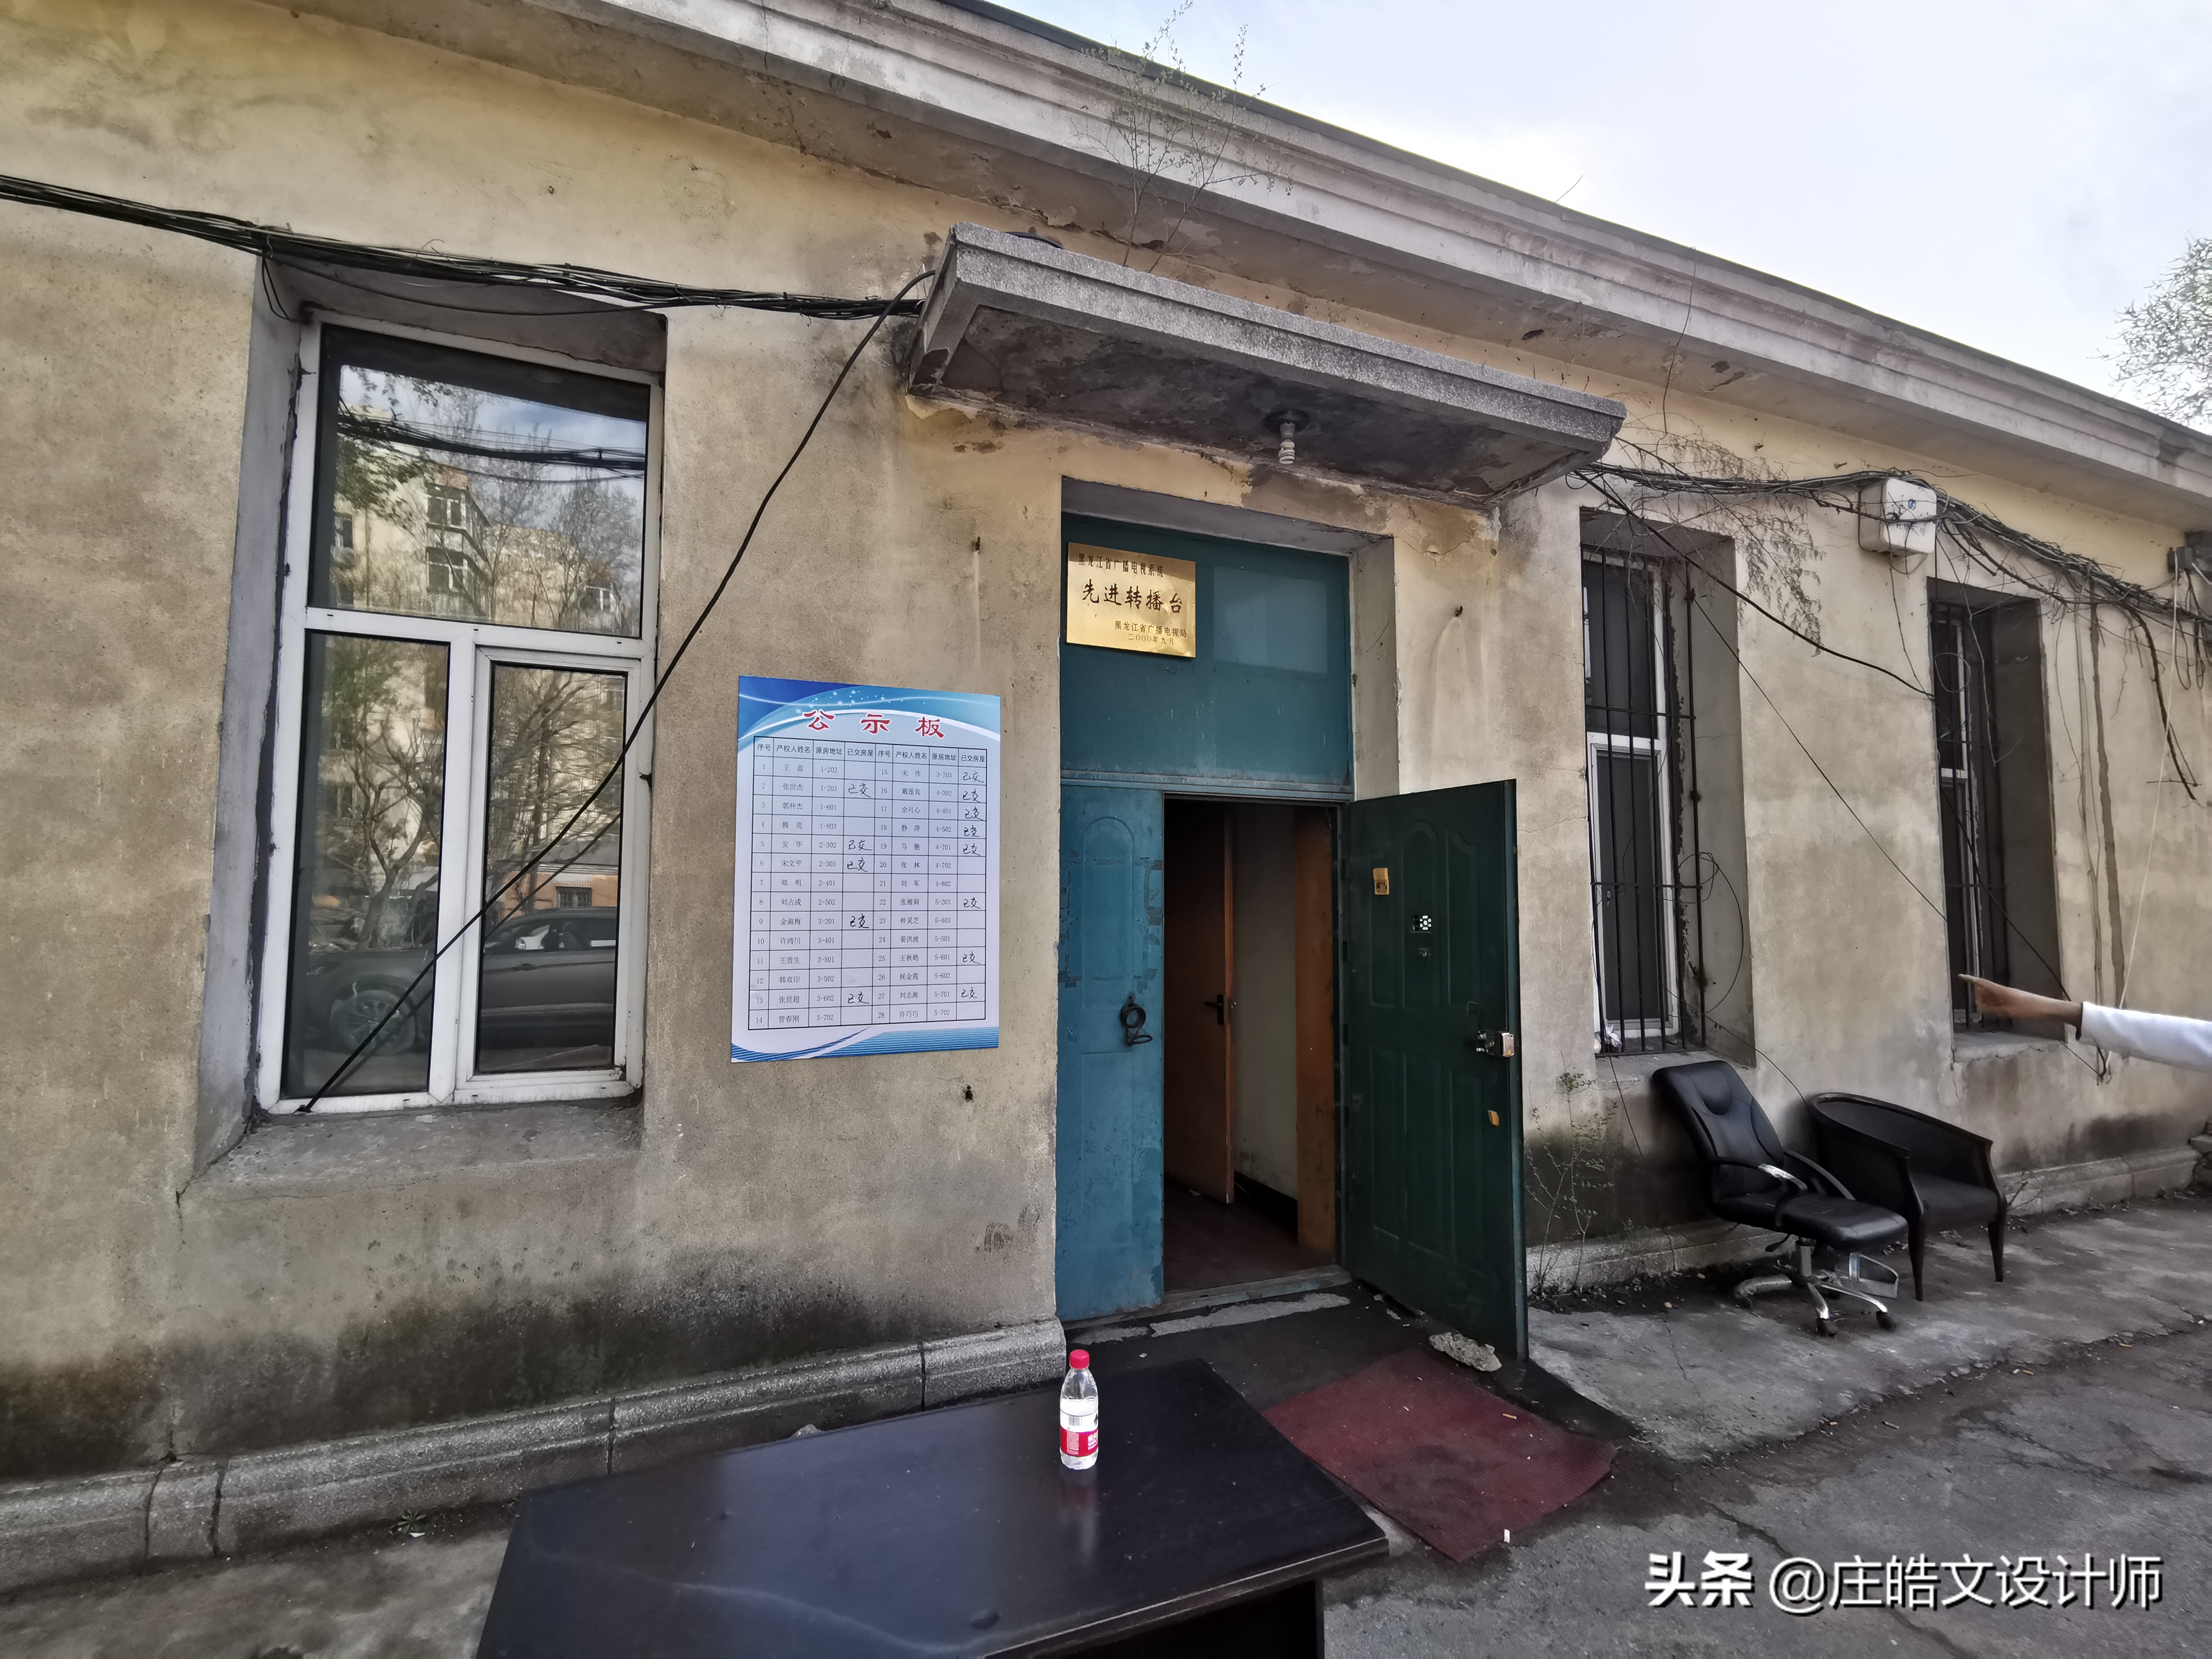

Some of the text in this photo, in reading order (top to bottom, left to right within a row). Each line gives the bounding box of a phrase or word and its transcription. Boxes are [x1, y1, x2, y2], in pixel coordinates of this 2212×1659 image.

[1078, 553, 1163, 578] 黑龙江省广播电视系统
[1082, 578, 1183, 613] 先进转播台
[1114, 620, 1187, 638] 黑龙江省广播电视局
[802, 709, 946, 739] 公示板
[757, 743, 771, 752] 序号
[776, 744, 810, 753] 产权人姓名
[815, 747, 843, 755] 原房地址
[847, 748, 874, 757] 已交房屋
[895, 751, 927, 760] 产权人姓名
[932, 753, 957, 761] 原房地址
[961, 754, 985, 763] 已交房屋
[782, 783, 803, 791] 张世杰
[781, 859, 802, 868] 宋文平
[781, 898, 802, 906] 刘占成
[780, 917, 801, 925] 金淑梅
[780, 937, 801, 945] 许鸿川
[780, 956, 801, 964] 王贵生
[779, 976, 800, 984] 韩双印
[899, 991, 918, 999] 刘志海
[779, 995, 800, 1004] 张世超
[899, 1010, 918, 1018] 许巧巧
[778, 1015, 800, 1023] 管春刚
